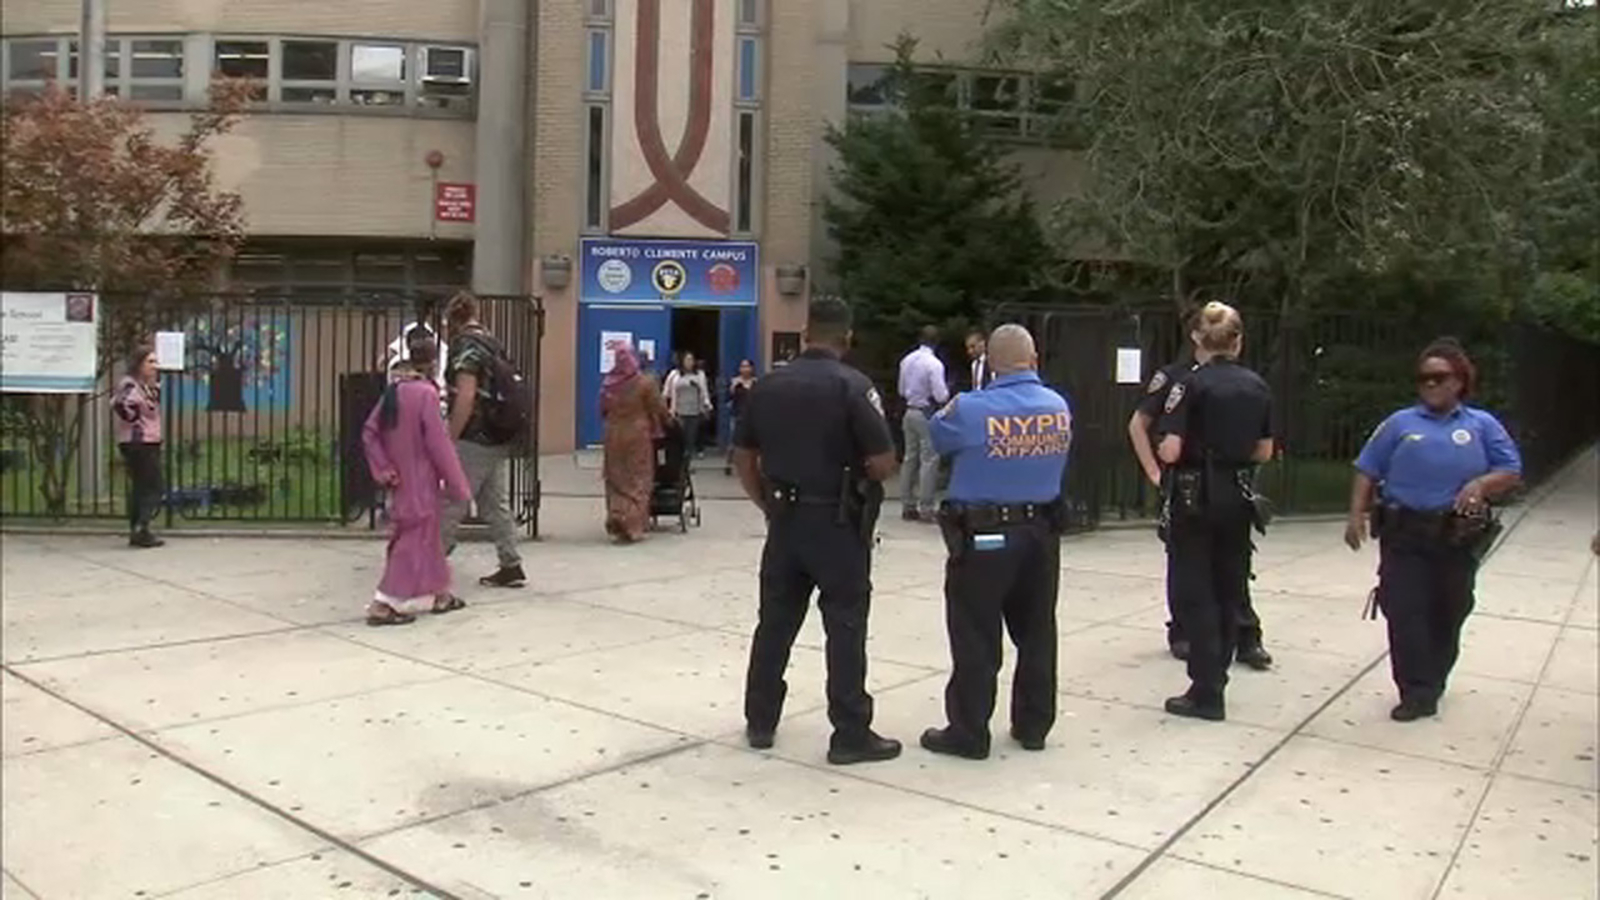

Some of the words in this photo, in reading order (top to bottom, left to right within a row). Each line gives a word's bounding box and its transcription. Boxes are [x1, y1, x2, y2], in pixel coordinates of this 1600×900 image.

[591, 247, 641, 258] ROBERTO
[643, 248, 698, 260] CLEMENTE
[702, 249, 747, 261] CAMPUS
[987, 412, 1071, 436] NYPD
[987, 432, 1071, 447] COMMUNIT
